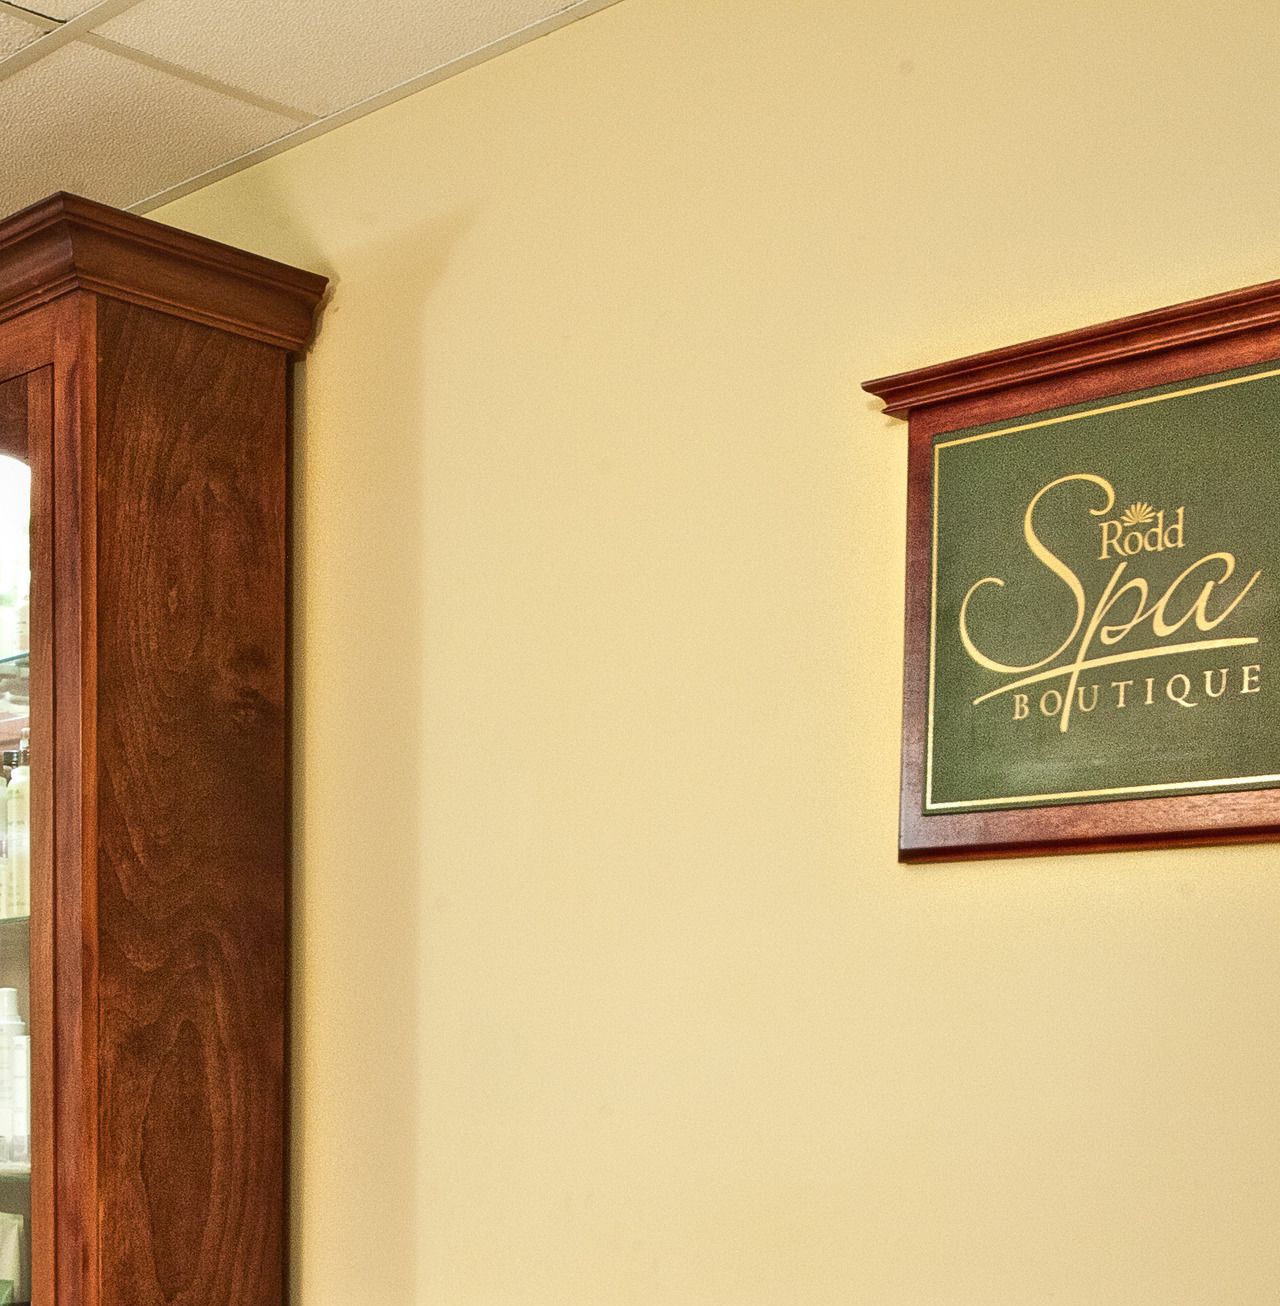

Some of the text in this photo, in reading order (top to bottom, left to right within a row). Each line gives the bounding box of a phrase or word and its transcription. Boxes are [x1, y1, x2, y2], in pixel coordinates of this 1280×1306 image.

[1099, 506, 1186, 561] Rodd
[959, 473, 1262, 733] Spa
[1012, 663, 1262, 721] BOUTIQUE
